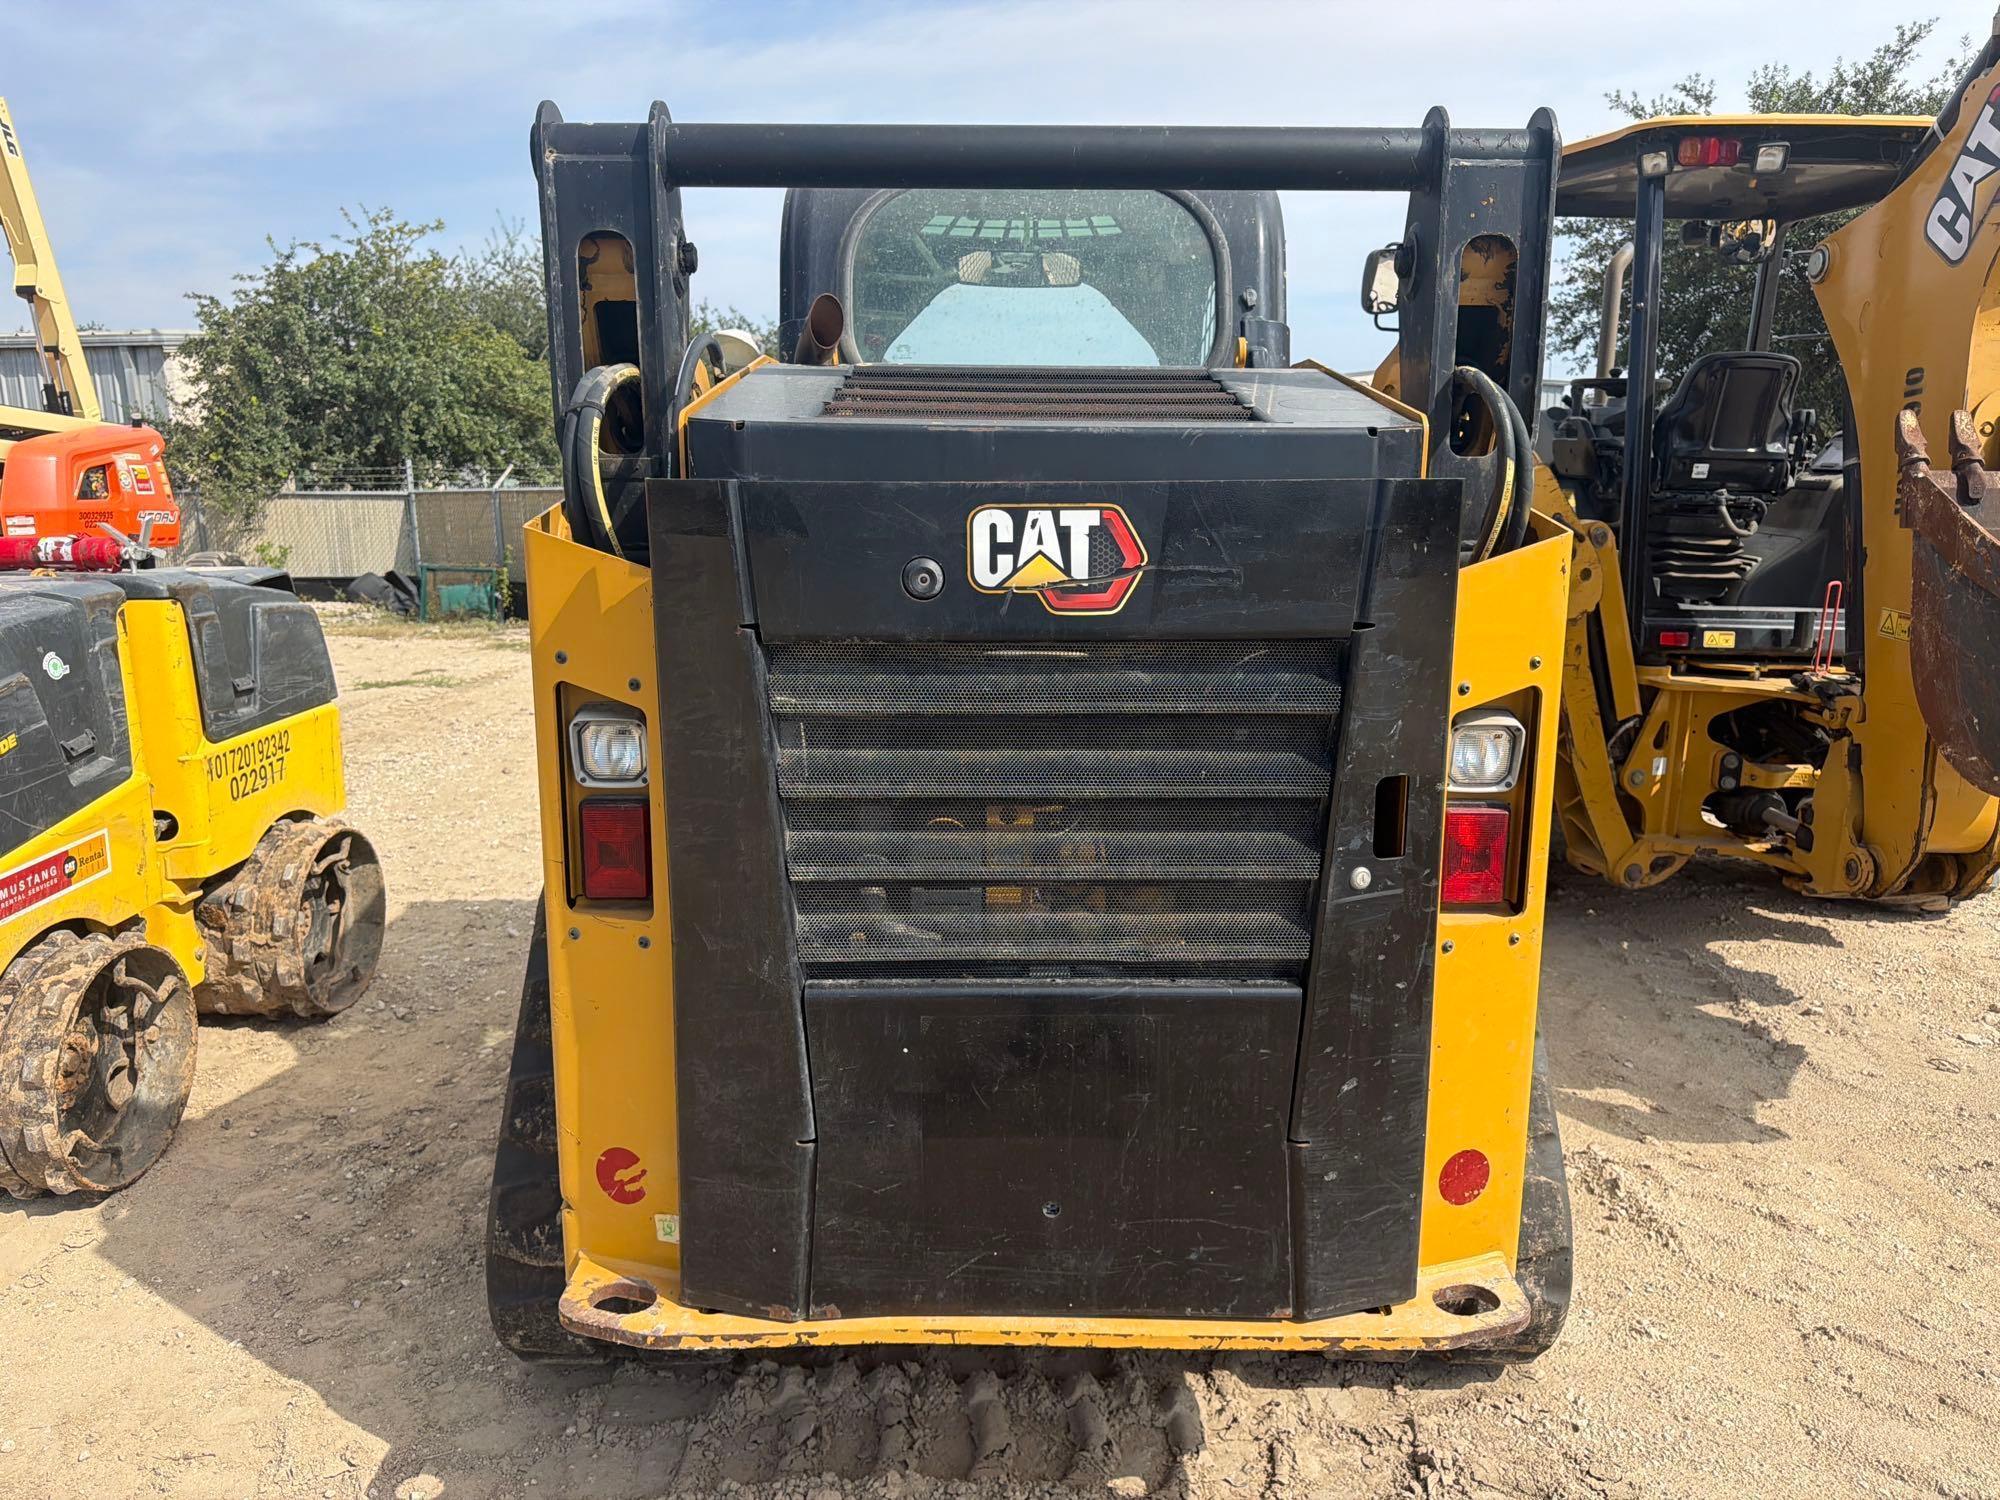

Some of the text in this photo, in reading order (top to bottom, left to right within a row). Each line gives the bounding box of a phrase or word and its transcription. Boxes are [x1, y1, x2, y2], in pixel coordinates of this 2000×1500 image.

[1926, 104, 2000, 262] CAT
[972, 508, 1101, 588] CAT
[230, 756, 285, 802] 022917
[78, 847, 105, 868] Rental
[0, 865, 58, 901] MUSTANG
[0, 877, 58, 909] RENTAL SERVICES
